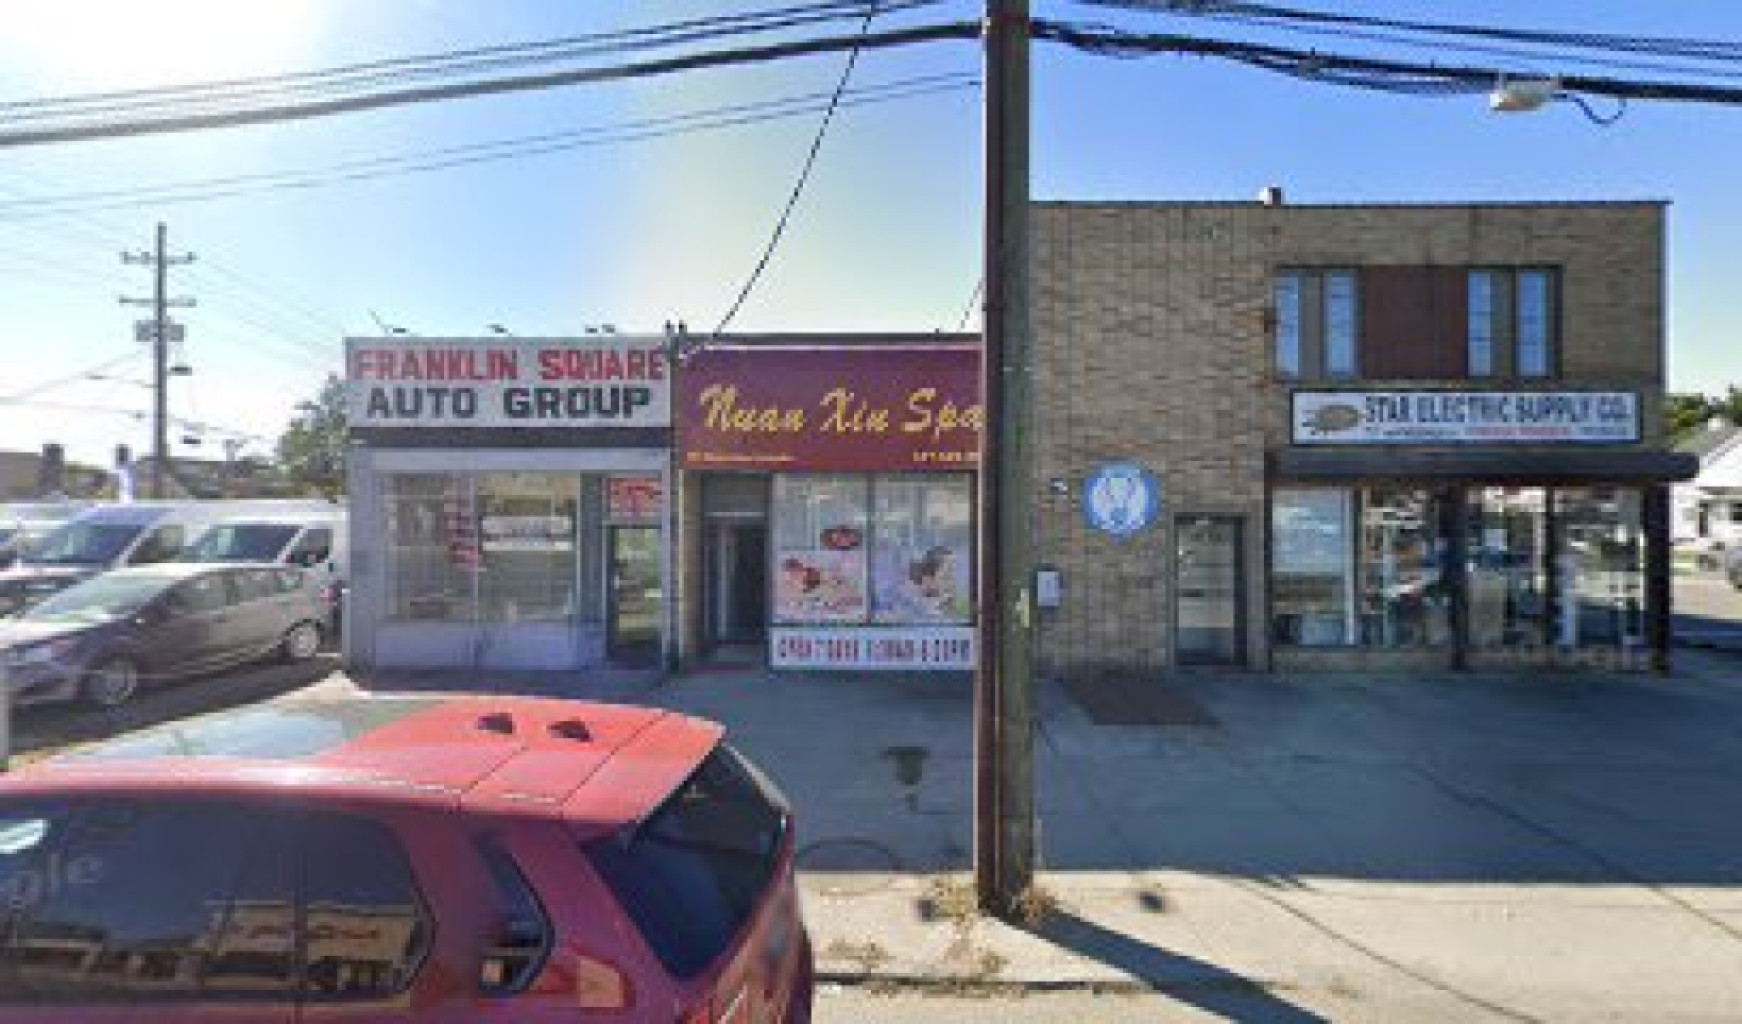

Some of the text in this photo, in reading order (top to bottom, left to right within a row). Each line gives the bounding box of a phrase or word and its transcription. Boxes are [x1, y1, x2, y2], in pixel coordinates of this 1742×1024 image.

[352, 346, 666, 381] FRANKLIN SQUARE
[366, 387, 651, 419] AUTO GROUP
[700, 384, 986, 442] Nuan Xin Spa
[1365, 395, 1410, 423] STAR
[1416, 395, 1510, 423] ELECTRIC
[1515, 394, 1591, 423] SUPPLY
